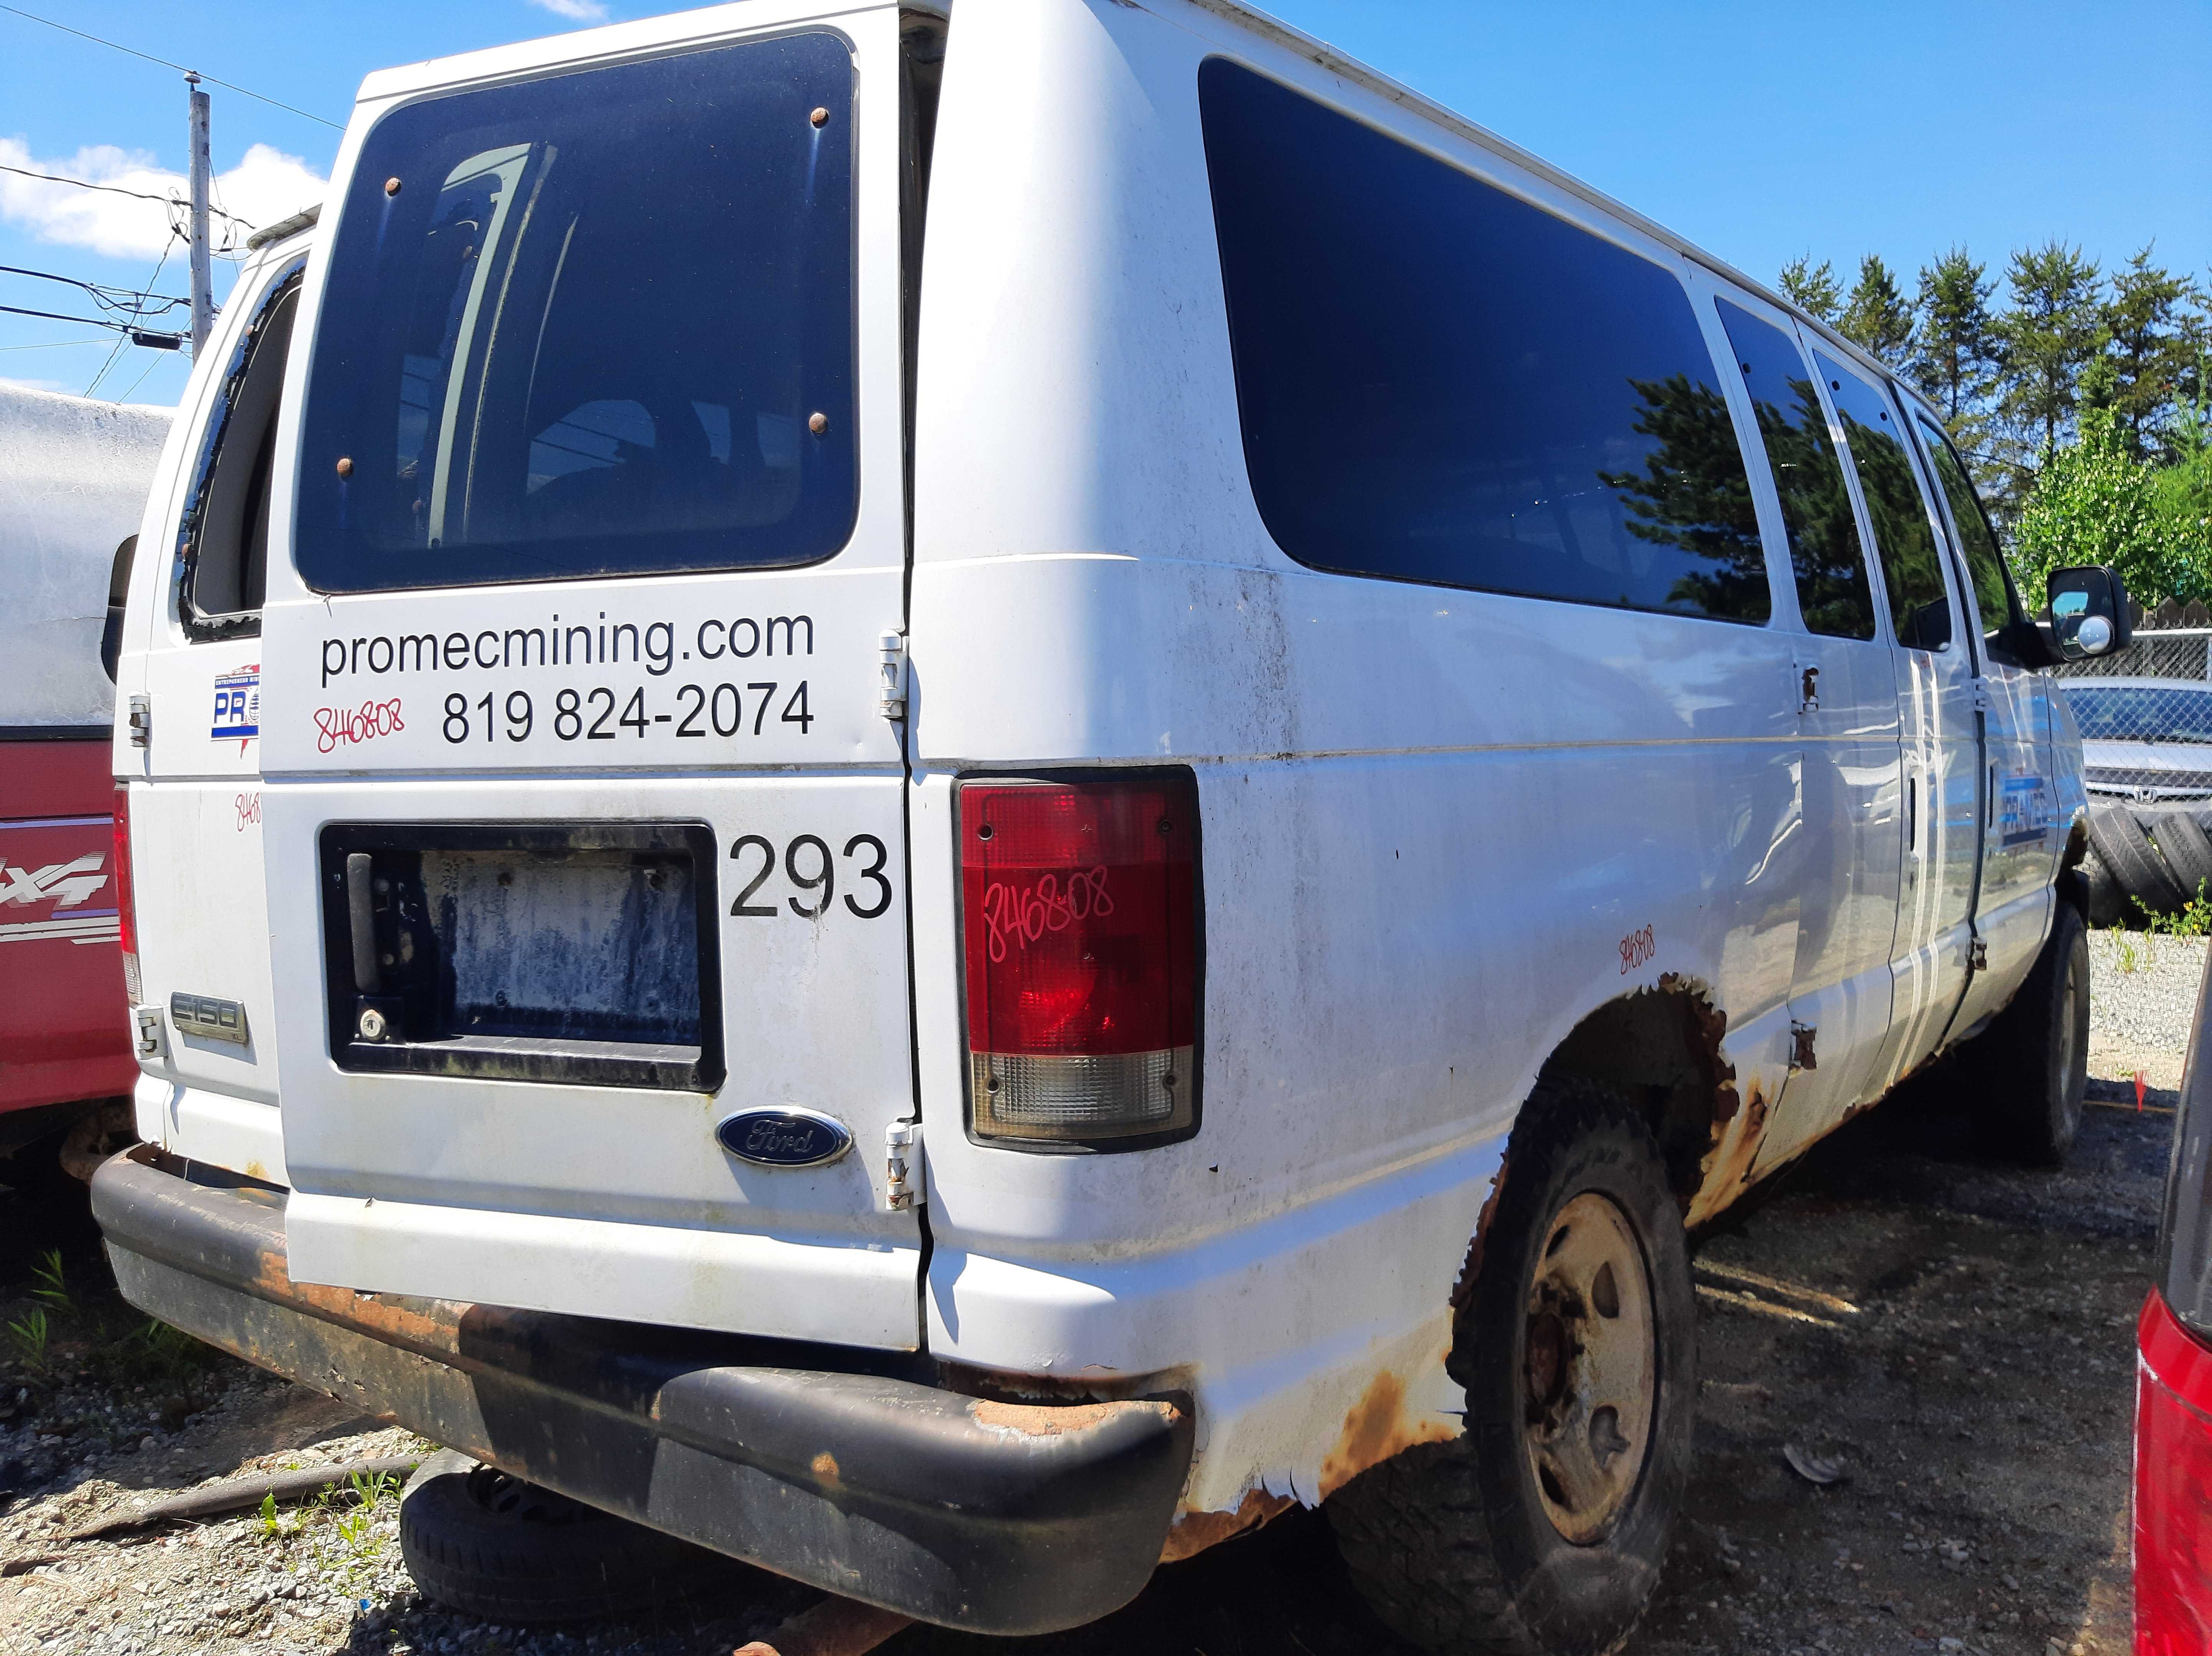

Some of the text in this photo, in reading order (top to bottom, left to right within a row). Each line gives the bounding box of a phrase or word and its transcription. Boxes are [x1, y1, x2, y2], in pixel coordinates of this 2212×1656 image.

[321, 611, 813, 689] promecmining.com
[442, 681, 815, 744] 819 824-2074
[730, 833, 892, 919] 293
[746, 1119, 814, 1153] Ford
